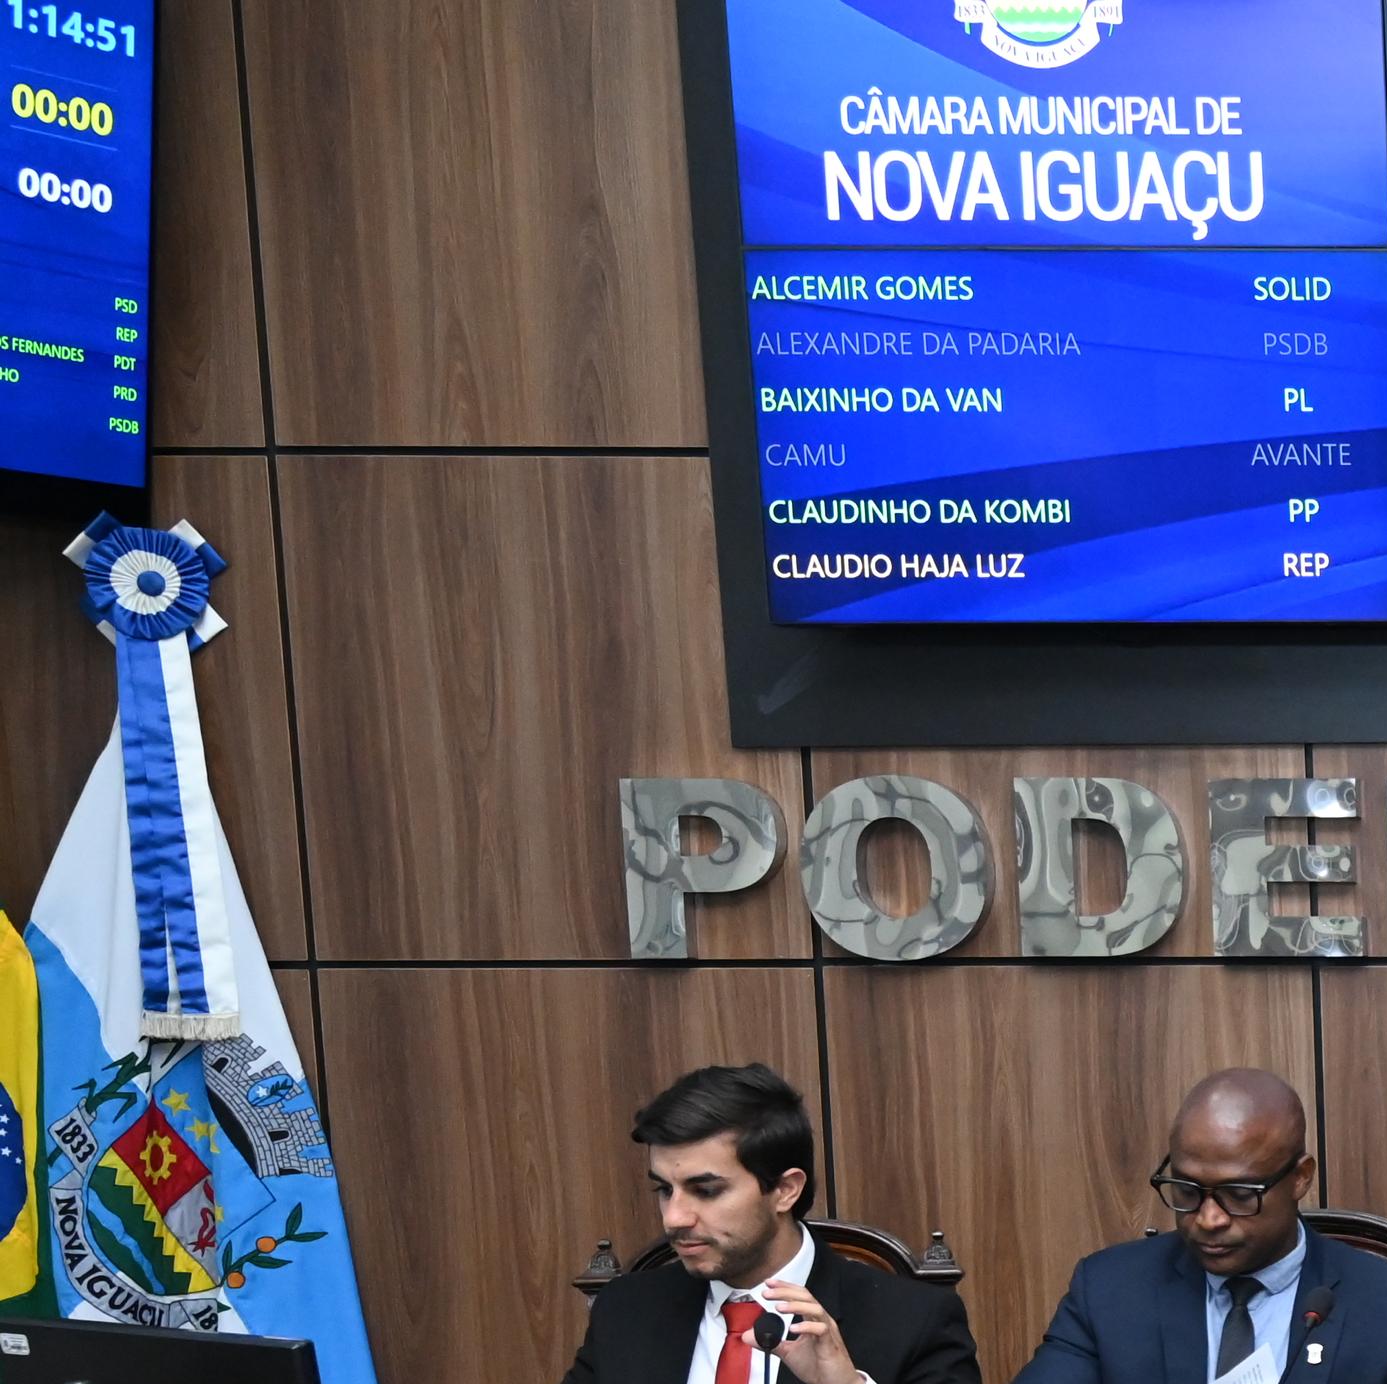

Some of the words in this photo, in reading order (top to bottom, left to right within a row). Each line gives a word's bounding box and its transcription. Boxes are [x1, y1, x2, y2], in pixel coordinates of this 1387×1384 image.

[10, 82, 115, 137] 00:00
[838, 85, 996, 136] CÂMARA
[996, 94, 1192, 137] MUNICIPAL
[1194, 95, 1244, 136] DE
[16, 166, 114, 214] 00:00
[822, 148, 1011, 223] NOVA
[1018, 148, 1265, 242] IGUAÇU
[750, 274, 870, 302] ALCEMIR
[874, 274, 975, 302] GOMES
[1252, 275, 1333, 302] SOLID
[114, 297, 138, 314] PSD
[115, 326, 138, 343] REP
[755, 330, 914, 357] ALEXANDRE
[921, 331, 961, 357] DA
[967, 331, 1082, 357] PADARIA
[1262, 331, 1329, 357] PSDB
[10, 336, 86, 364] FERNANDES
[113, 354, 137, 371] PDT
[113, 385, 138, 402] PRD
[759, 386, 895, 414] BAIXINHO
[900, 386, 941, 414] DA
[944, 386, 1004, 414] VAN
[1283, 386, 1315, 413] PL
[109, 417, 139, 435] PSDB
[764, 442, 847, 468] CAMU
[1250, 442, 1353, 467] AVANTE
[767, 498, 933, 525] CLAUDINHO
[938, 498, 979, 525] DA
[983, 498, 1072, 525] KOMBI
[1287, 497, 1321, 524] PP
[771, 552, 894, 580] CLAUDIO
[899, 552, 970, 579] HAJA
[974, 552, 1027, 579] LUZ
[1282, 551, 1331, 578] REP
[55, 1116, 96, 1164] 1833
[55, 1195, 89, 1272] NOVA
[192, 1304, 219, 1333] 18
